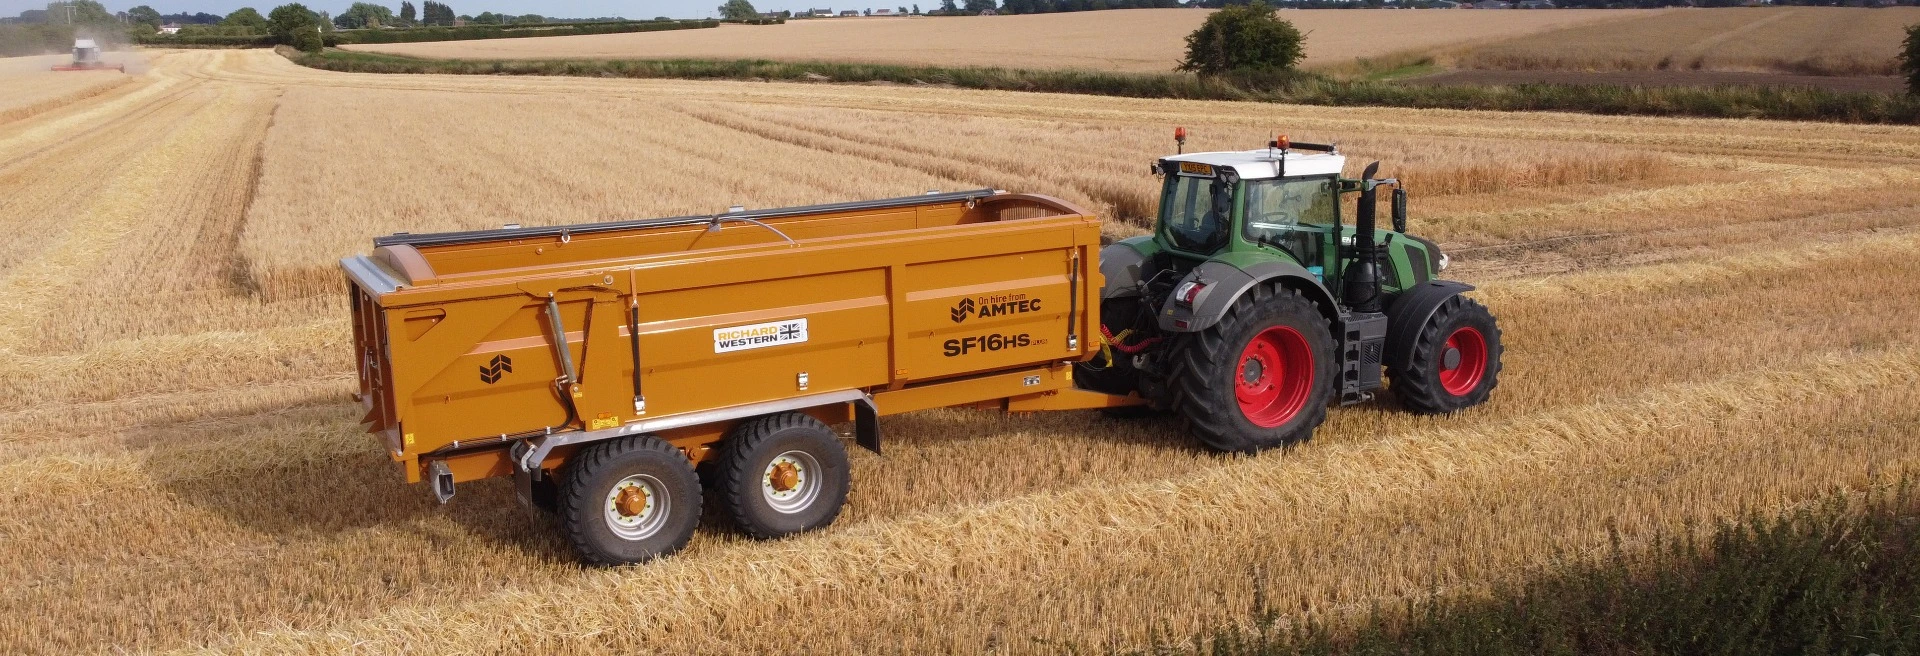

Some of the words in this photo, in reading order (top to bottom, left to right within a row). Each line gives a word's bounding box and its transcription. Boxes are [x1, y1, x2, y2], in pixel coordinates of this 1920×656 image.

[978, 296, 989, 305] On
[990, 294, 1007, 304] hire
[1009, 293, 1026, 302] from
[978, 298, 1042, 318] AMTEC
[718, 326, 778, 341] RICHARD
[719, 334, 778, 349] WESTERN
[943, 333, 1030, 357] SF16HS
